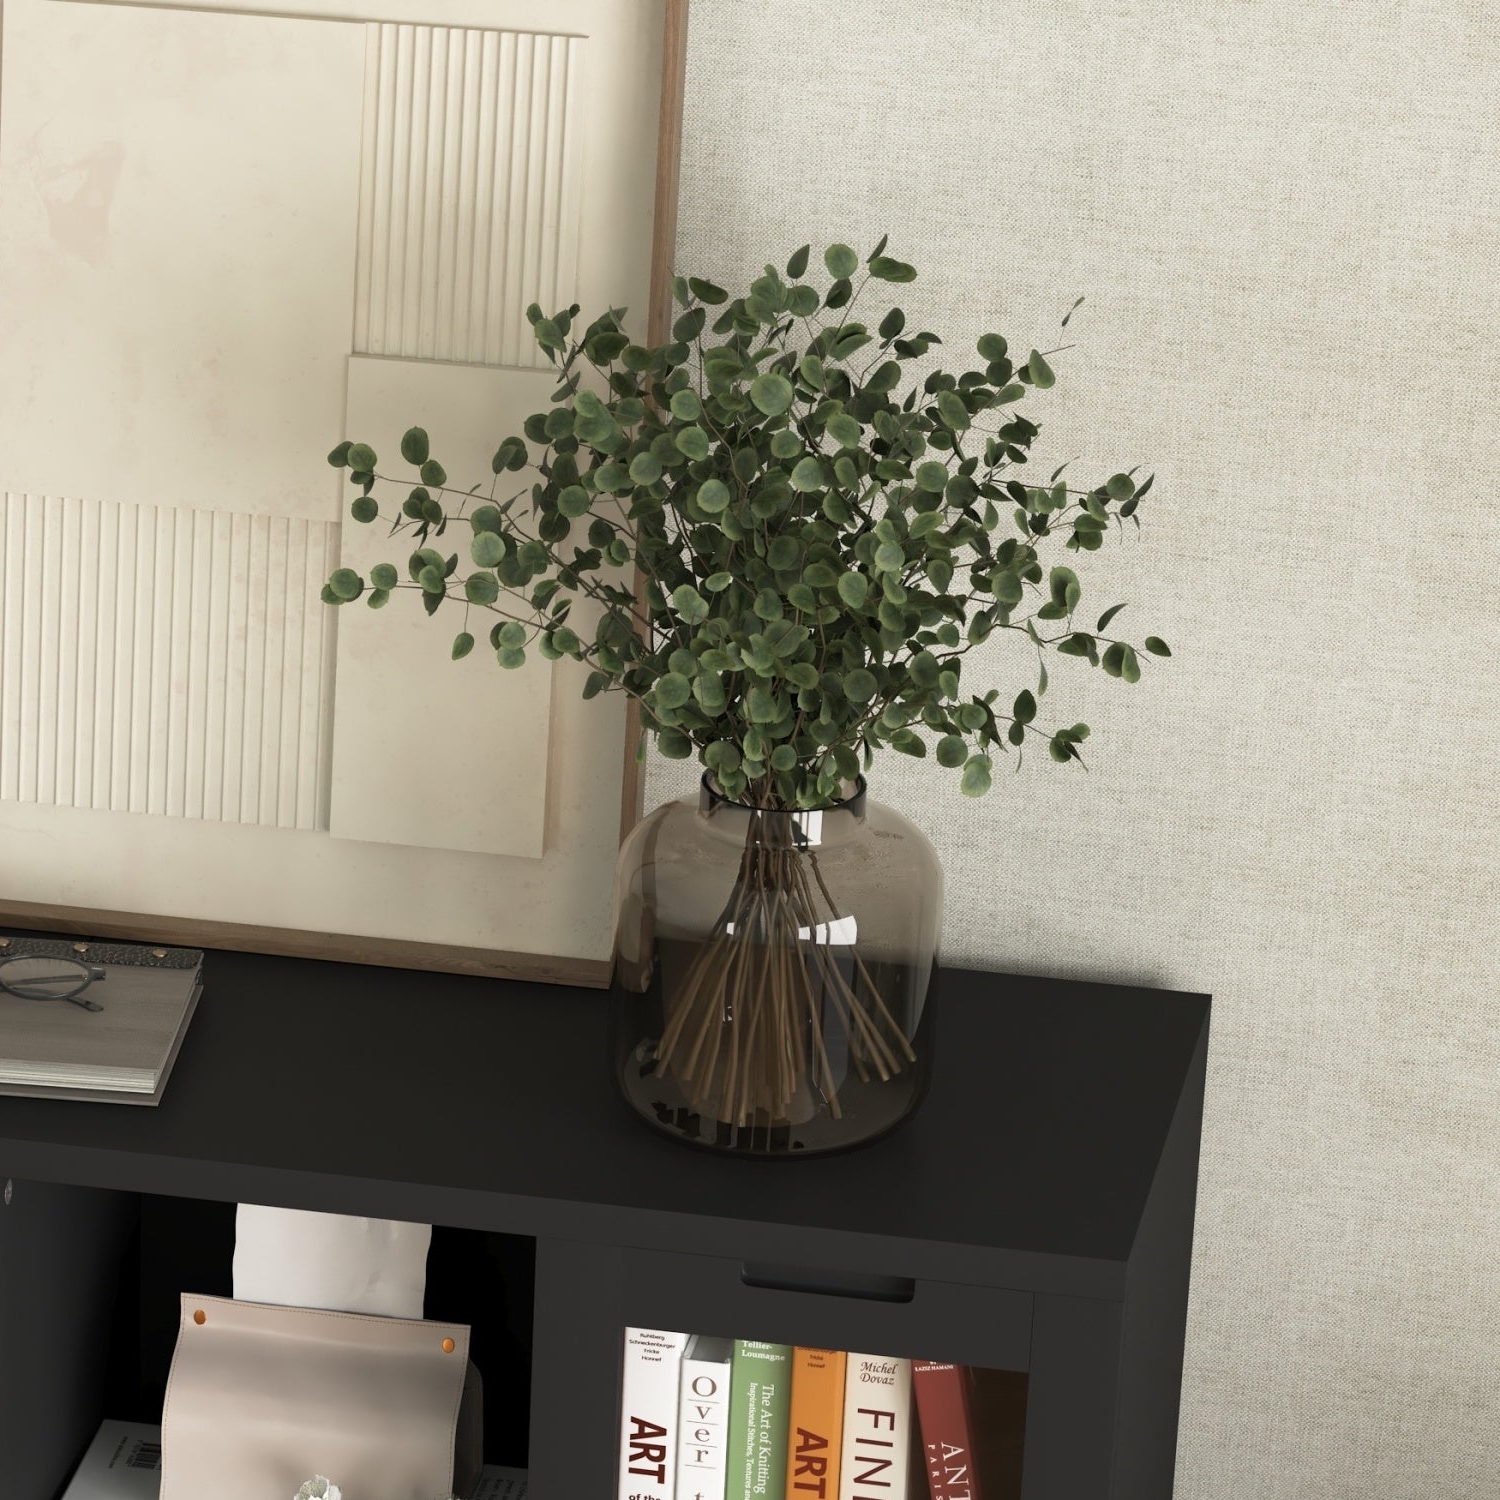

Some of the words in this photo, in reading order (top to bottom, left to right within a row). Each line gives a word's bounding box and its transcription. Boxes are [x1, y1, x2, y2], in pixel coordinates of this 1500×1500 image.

[741, 1349, 785, 1362] Loumagne
[742, 1340, 772, 1350] Tellier-
[860, 1361, 898, 1375] Michel
[860, 1373, 895, 1386] Dovaz
[747, 1382, 758, 1427] Inspirational
[761, 1384, 775, 1407] The
[760, 1409, 773, 1429] Art
[629, 1415, 668, 1484] ART
[759, 1433, 772, 1445] of
[744, 1458, 755, 1489] Textures
[753, 1446, 771, 1494] Knitting
[793, 1427, 829, 1499] ART
[928, 1444, 944, 1500] PARIS
